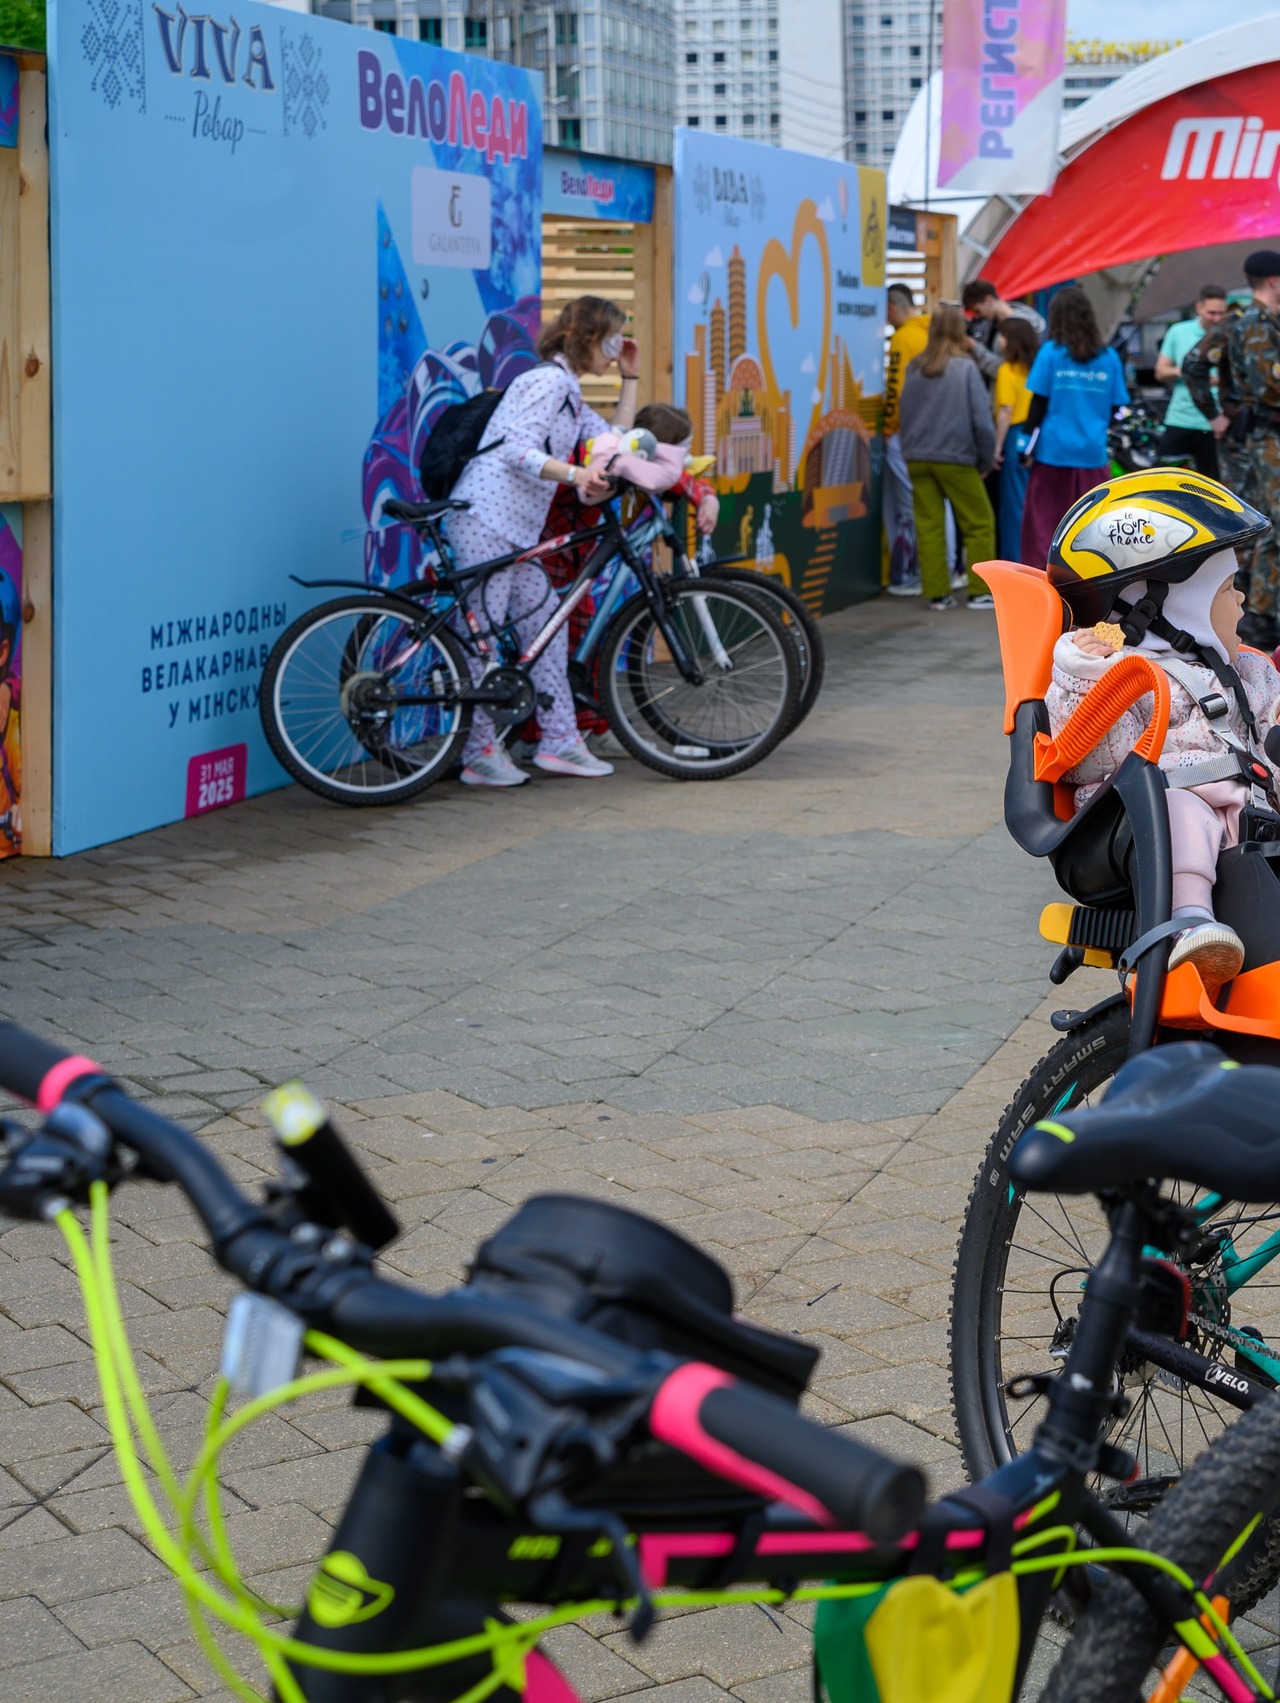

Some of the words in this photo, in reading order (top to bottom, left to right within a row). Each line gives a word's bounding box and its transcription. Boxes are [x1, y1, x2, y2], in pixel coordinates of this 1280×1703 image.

[153, 3, 275, 92] VIVA
[193, 90, 244, 155] Ровар
[357, 49, 529, 166] ВелоЛеди
[560, 170, 614, 205] ВелоЛеди
[1113, 518, 1150, 535] TOUR
[150, 602, 287, 650] МІЖНАРОДНЫ
[142, 643, 270, 693] ВЕЛАКАРНАВ
[168, 701, 180, 729] У
[200, 763, 213, 782] 31
[214, 757, 234, 780] МАЯ
[198, 776, 234, 809] 2025
[1042, 1035, 1107, 1099] SMART
[1215, 1369, 1249, 1393] VELO
